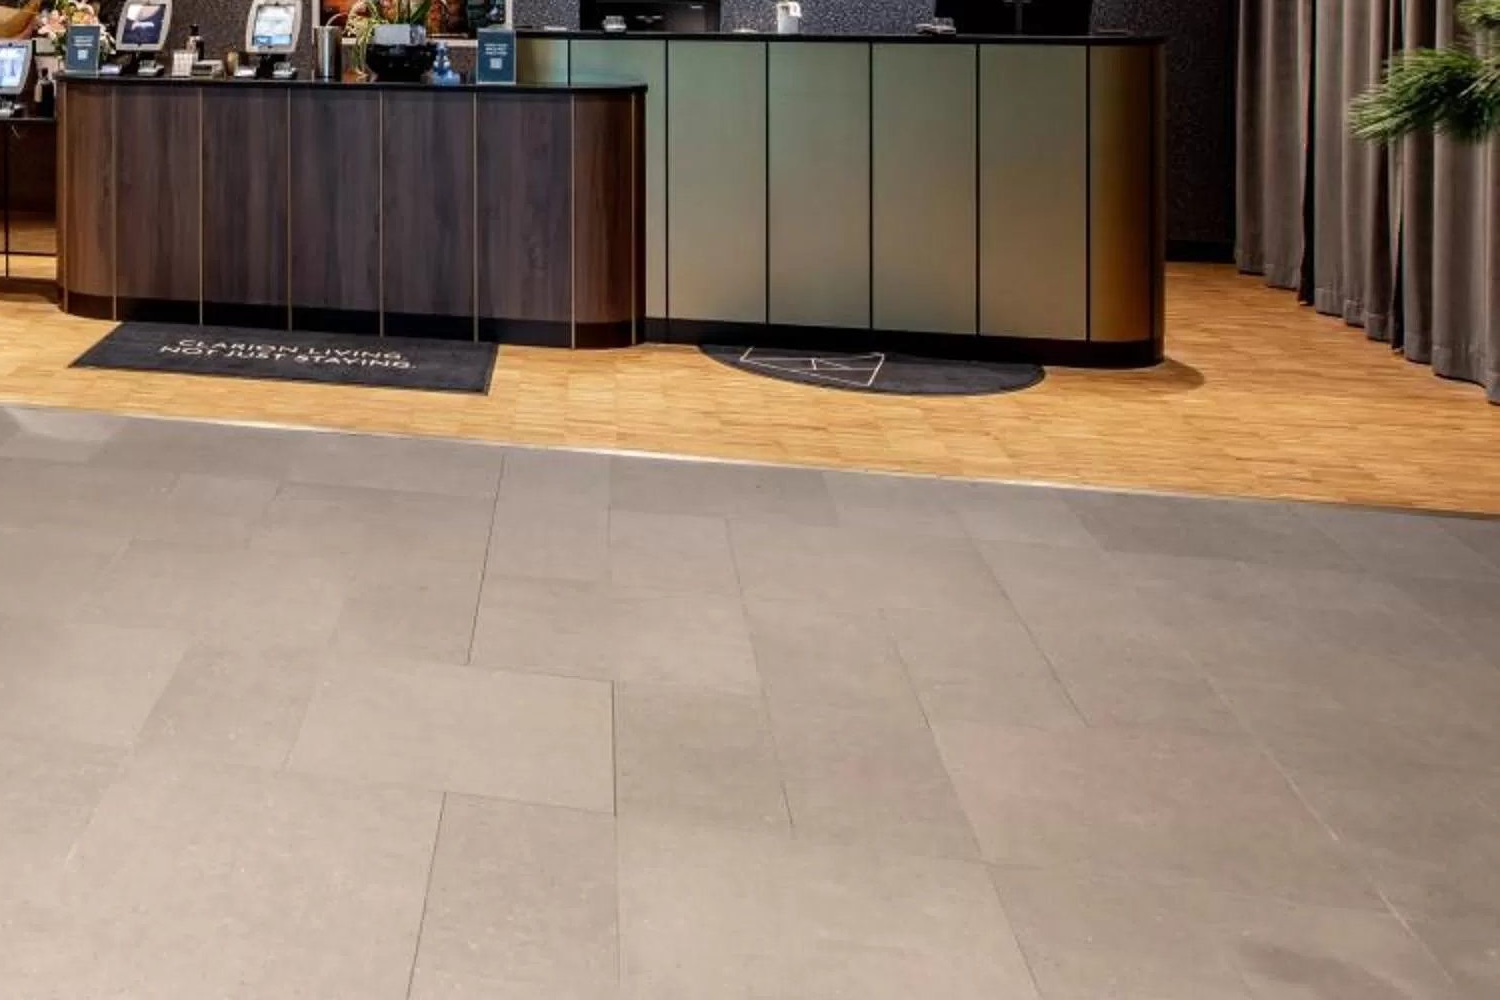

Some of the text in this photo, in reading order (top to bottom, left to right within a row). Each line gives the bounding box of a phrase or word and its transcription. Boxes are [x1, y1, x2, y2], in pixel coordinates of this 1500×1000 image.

[160, 345, 219, 356] NOT
[224, 350, 287, 361] JUST
[179, 340, 299, 353] CLARION
